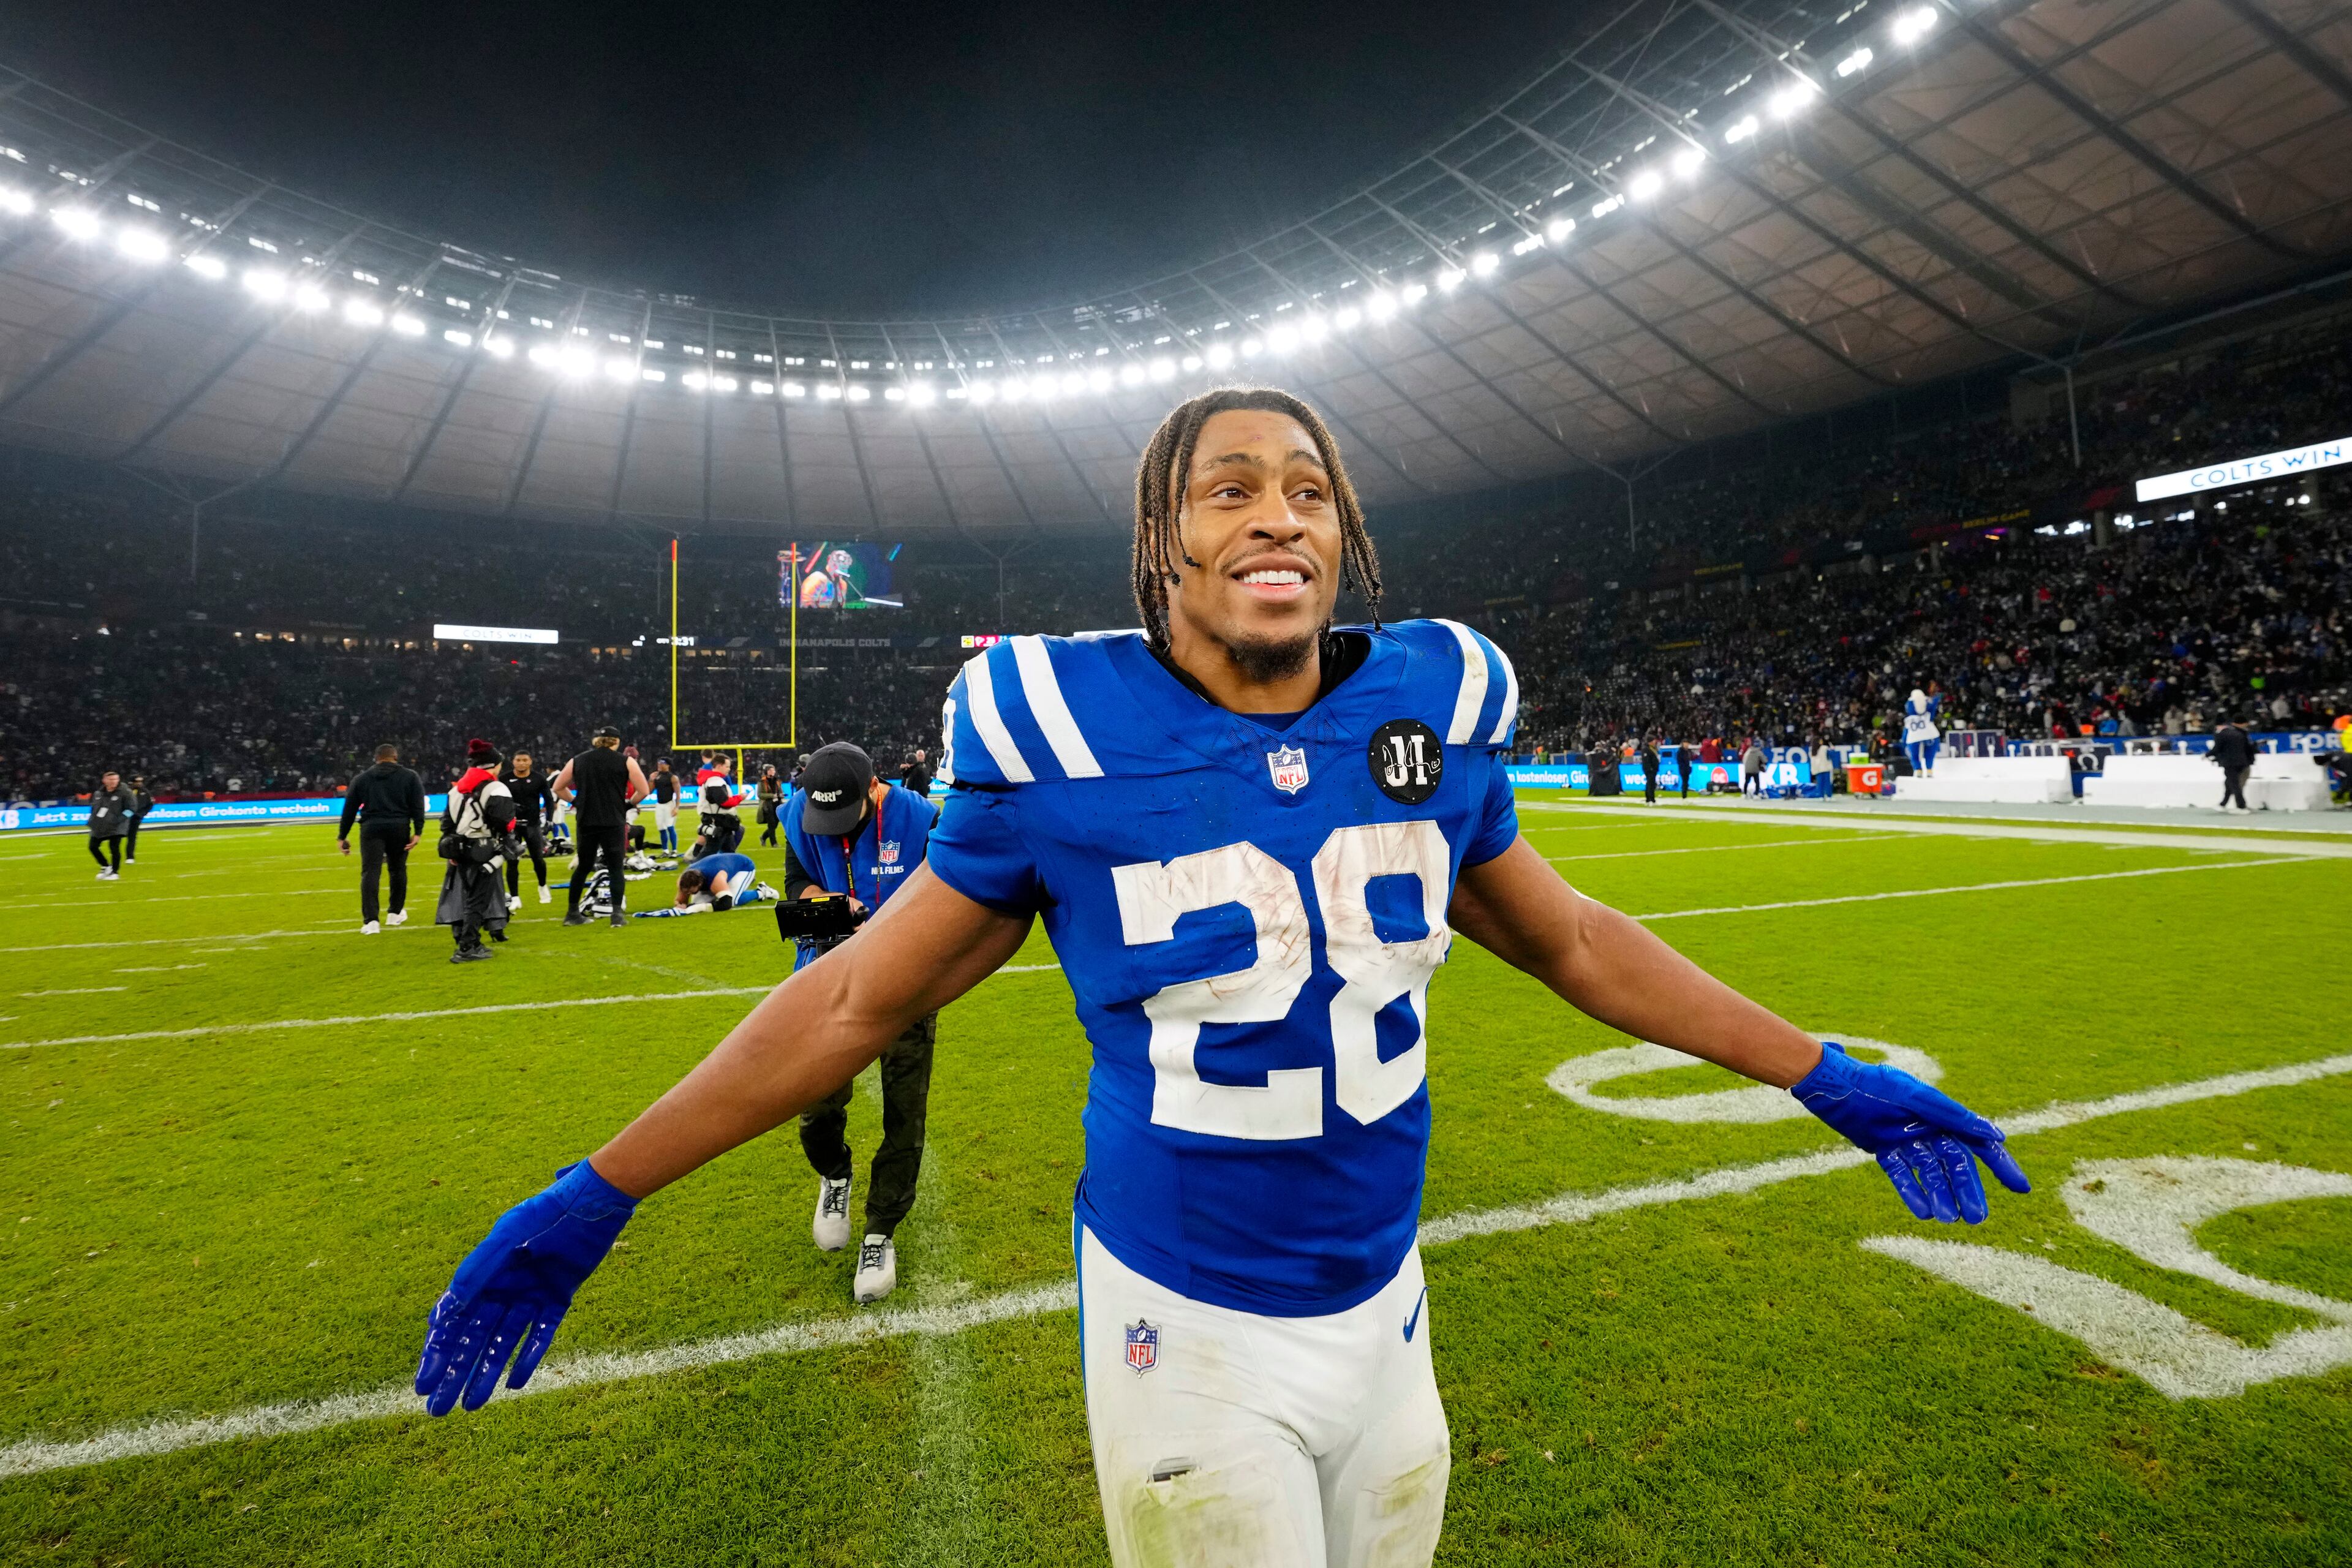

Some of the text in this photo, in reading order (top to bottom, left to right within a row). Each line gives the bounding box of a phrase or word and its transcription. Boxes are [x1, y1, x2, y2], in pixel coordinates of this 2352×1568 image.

[2191, 445, 2342, 487] COLTS WIN
[463, 629, 502, 639] COLTS
[858, 638, 891, 647] COLTS
[1862, 771, 1878, 786] G
[812, 790, 837, 802] ARRI
[32, 812, 67, 823] Jetzt
[200, 805, 267, 818] Girokonto
[270, 802, 330, 815] wechseln
[882, 851, 896, 861] NFL
[885, 865, 904, 874] FILMS
[1110, 819, 1453, 1140] 28
[1128, 1343, 1154, 1367] NFL
